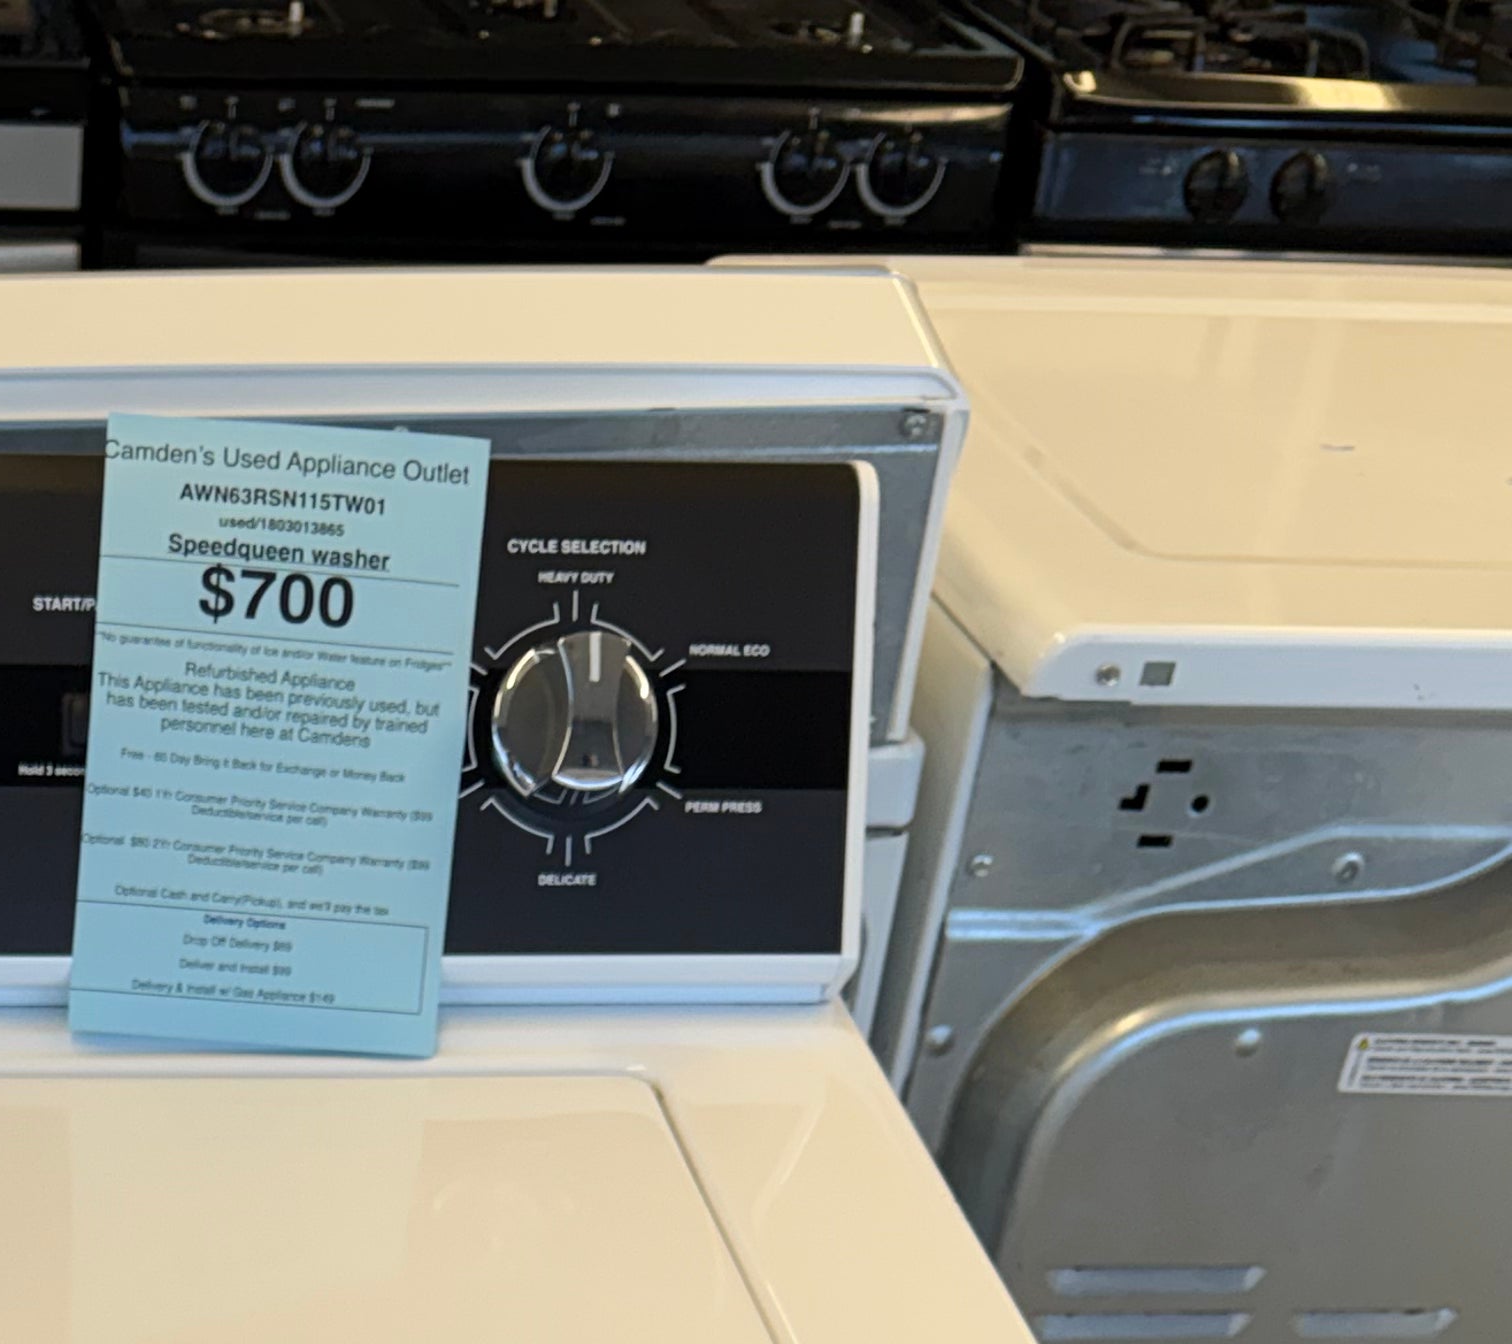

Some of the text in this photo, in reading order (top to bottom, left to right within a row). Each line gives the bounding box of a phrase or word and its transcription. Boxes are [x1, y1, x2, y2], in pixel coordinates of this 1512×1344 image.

[105, 439, 470, 485] Camden's Used Appliance Outlet
[180, 483, 385, 515] AWN63RSN115TW01
[168, 533, 390, 570] Speedqueen washer
[507, 539, 646, 555] CYCLE SELECTION
[538, 571, 614, 584] HEAVY DUTY
[199, 563, 354, 629] $700
[689, 645, 770, 657] NORMAL ECO
[185, 662, 356, 692] Refurbished Appliance
[98, 672, 130, 689] This
[134, 675, 209, 696] Appliance
[214, 683, 241, 699] has
[246, 686, 284, 702] been
[288, 692, 365, 714] previously
[415, 701, 440, 717] but
[106, 691, 428, 734] has been tested and/or repaired by trained
[160, 717, 371, 748] personnel here at Camdens
[120, 747, 144, 760] Free
[194, 754, 220, 769] Bring
[232, 758, 256, 770] Back
[260, 760, 273, 771] for
[275, 762, 327, 778] Exchange
[87, 783, 130, 797] Optional
[175, 790, 227, 804] Consumer
[309, 802, 358, 818] Company
[685, 801, 761, 813] PERM PRESS
[286, 814, 302, 826] per
[172, 840, 227, 854] Consumer
[307, 851, 356, 867] Company
[282, 863, 299, 874] per
[538, 874, 596, 886] DELICATE
[114, 885, 158, 898] Optional
[160, 888, 186, 900] Cash
[189, 890, 210, 902] and
[203, 913, 286, 931] Delivery Options
[183, 933, 208, 947] Drop
[211, 935, 227, 946] Off
[229, 937, 270, 953] Delivery
[179, 958, 215, 970] Deliver
[217, 960, 237, 972] and
[131, 978, 172, 994] Delivery
[257, 988, 306, 1003] Appliance
